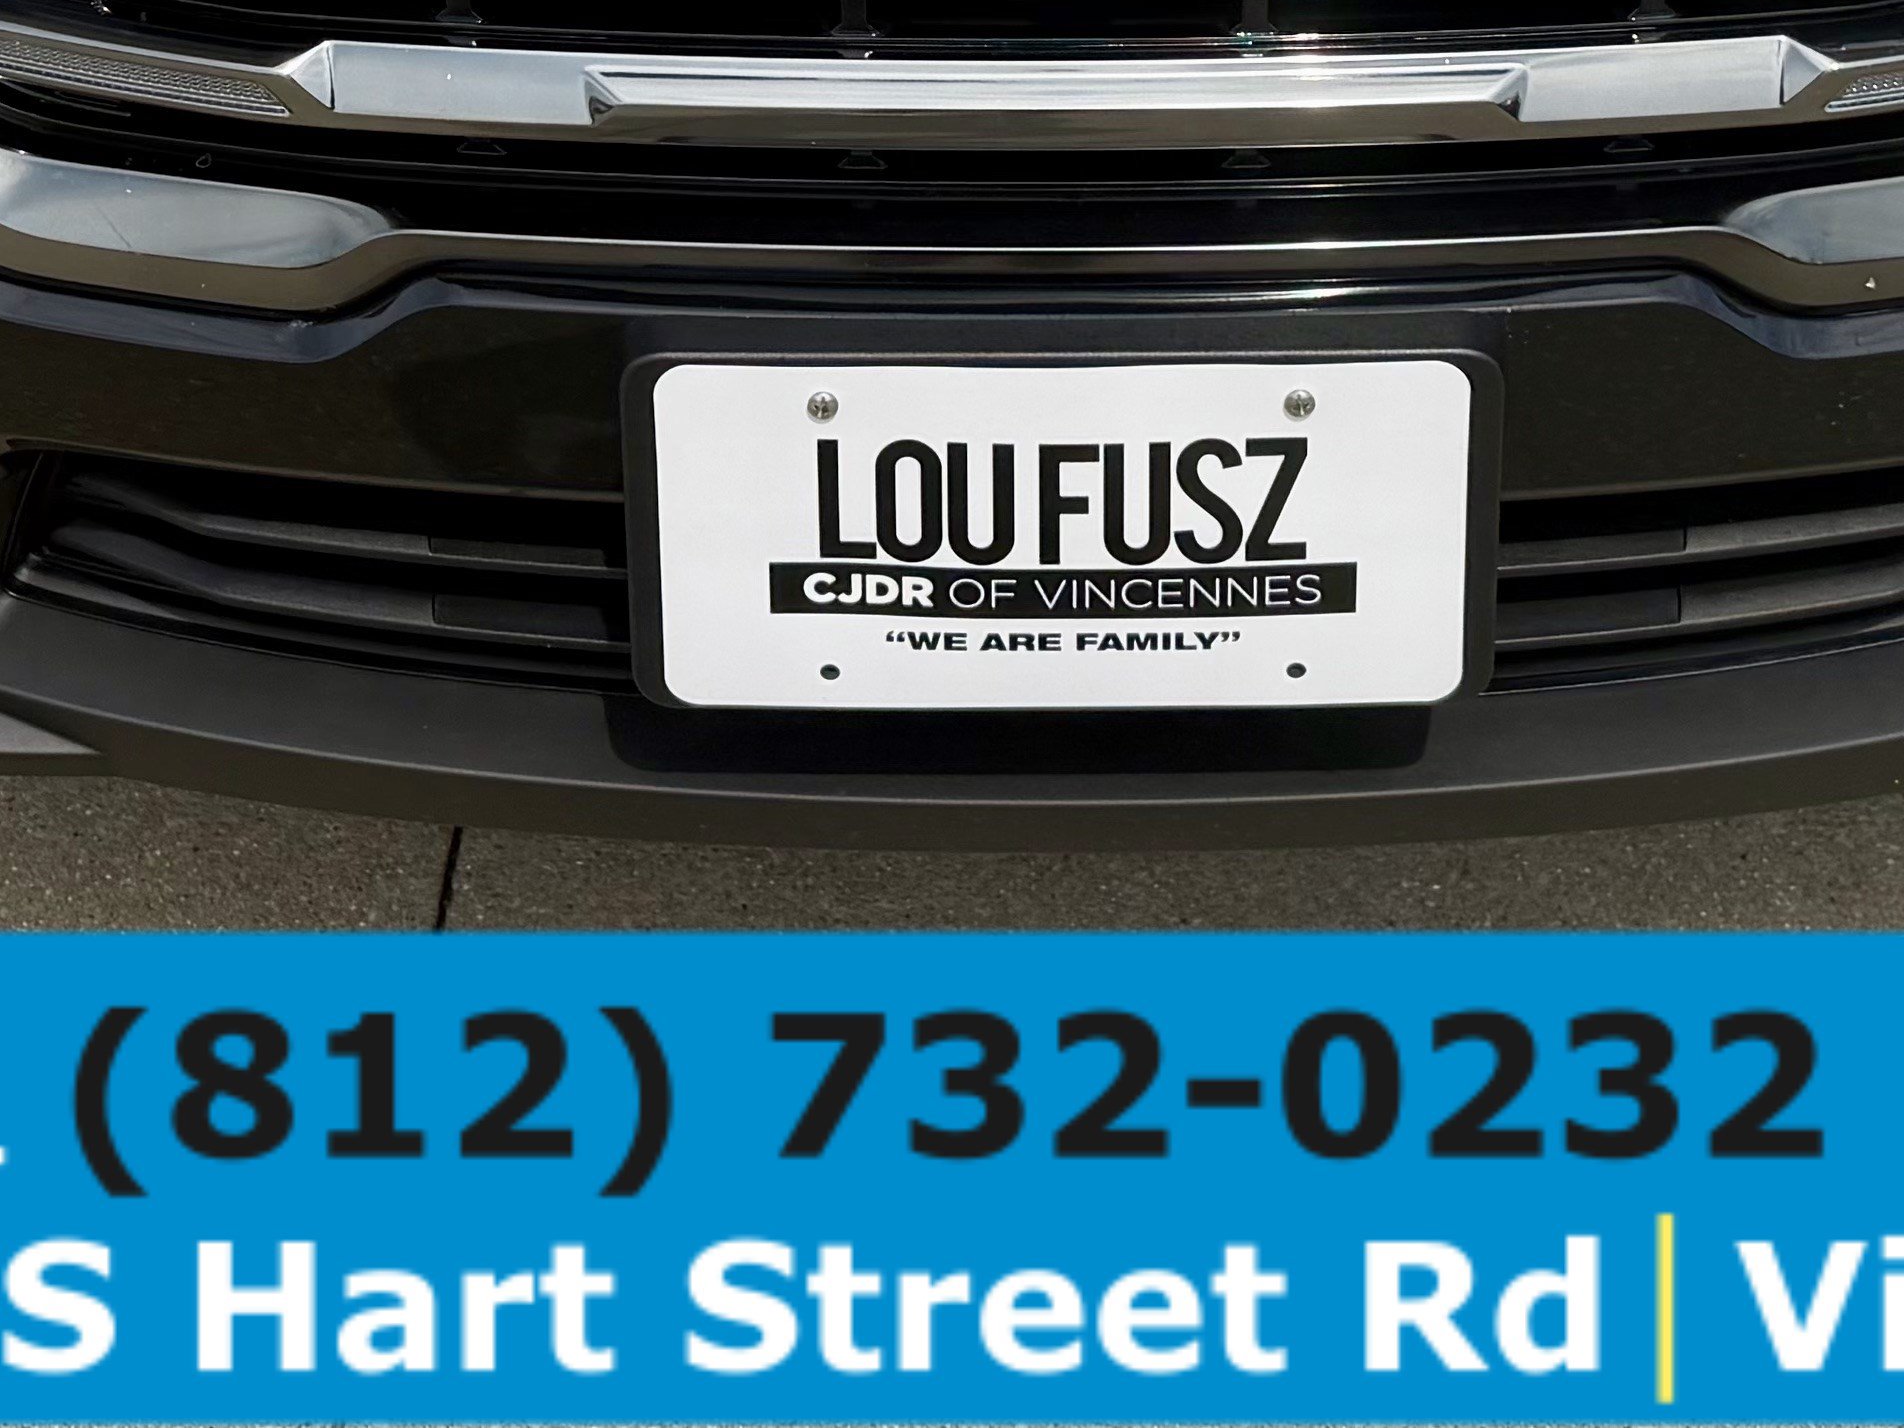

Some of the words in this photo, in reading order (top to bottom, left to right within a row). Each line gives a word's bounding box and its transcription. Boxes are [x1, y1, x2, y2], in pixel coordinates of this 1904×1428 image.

[817, 439, 1015, 565] LOU
[1039, 438, 1308, 565] FUSZ
[803, 572, 934, 608] CJDR
[949, 578, 1017, 609] OF
[1034, 573, 1323, 610] VINCENNES
[886, 630, 967, 651] “WE
[980, 632, 1062, 651] ARE
[1076, 630, 1241, 651] FAMILY”
